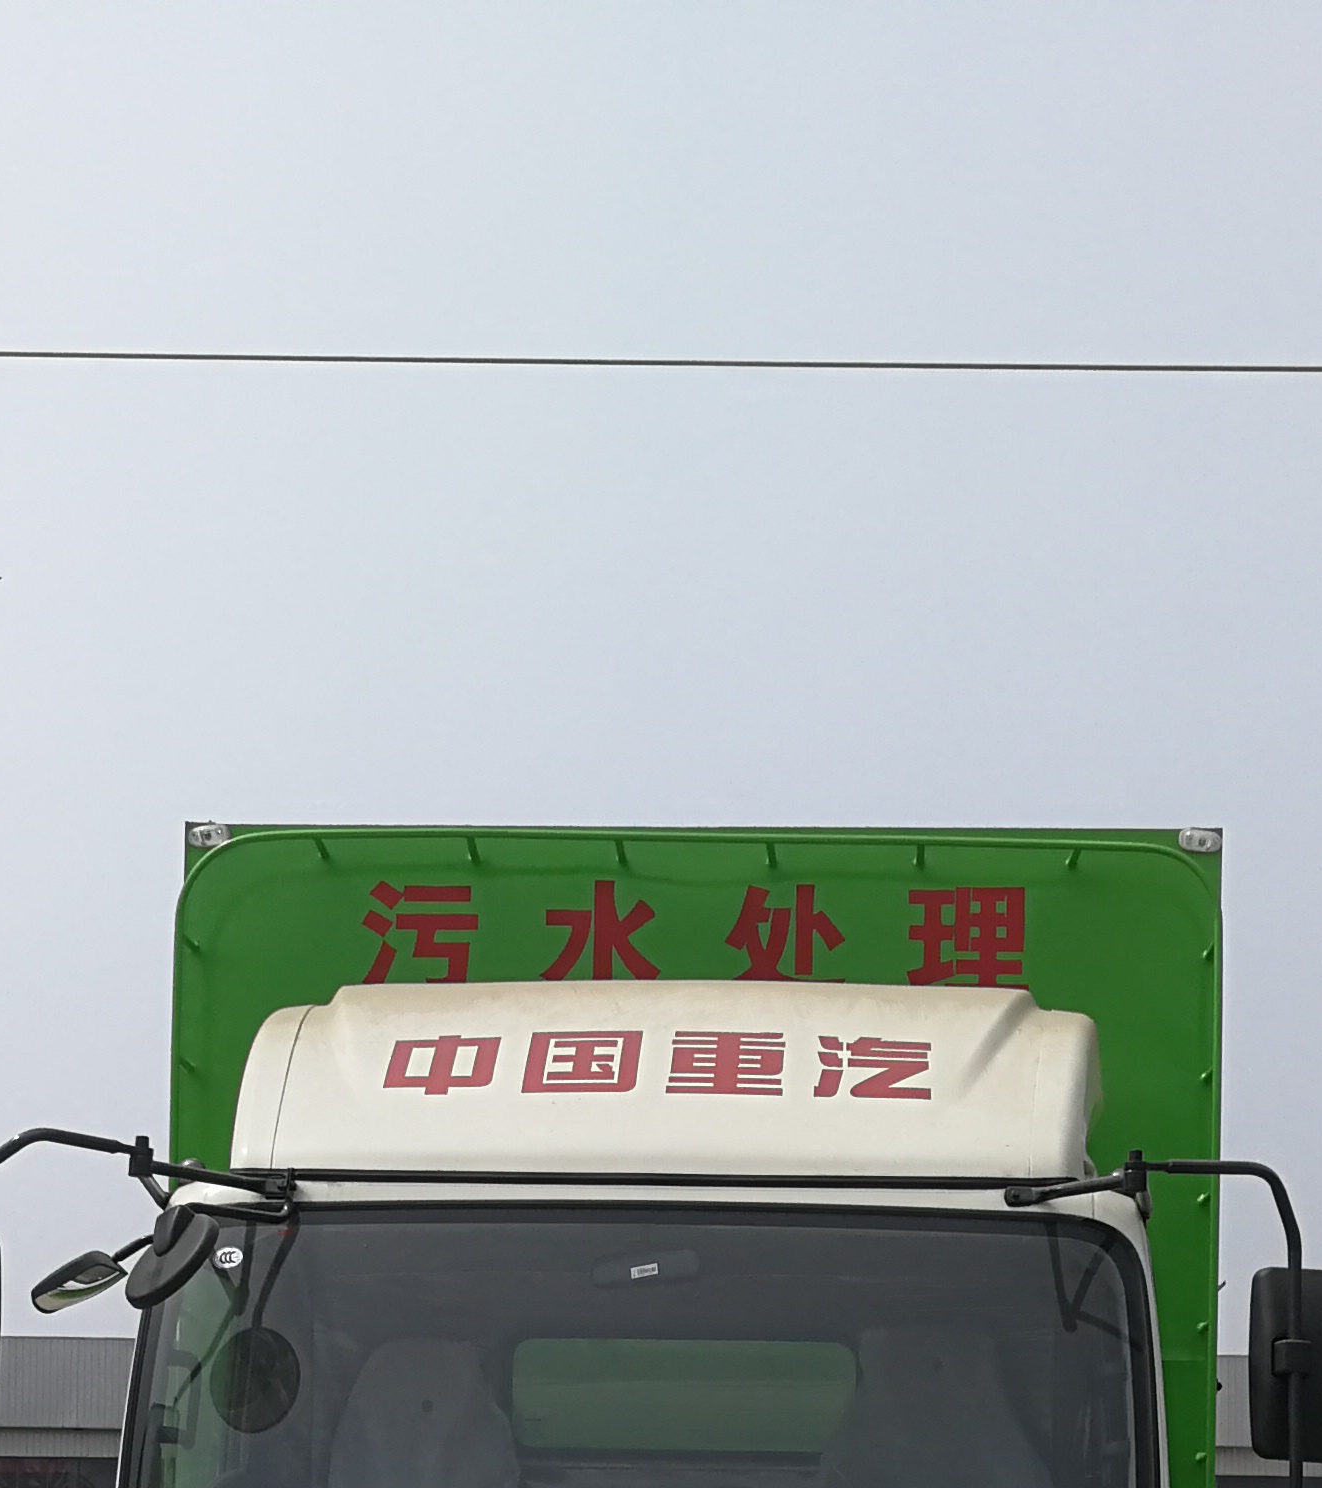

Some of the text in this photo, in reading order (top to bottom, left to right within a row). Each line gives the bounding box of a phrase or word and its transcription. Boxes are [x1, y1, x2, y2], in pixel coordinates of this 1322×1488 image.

[362, 880, 1029, 988] 污水处理
[383, 1030, 932, 1100] 中国重汽
